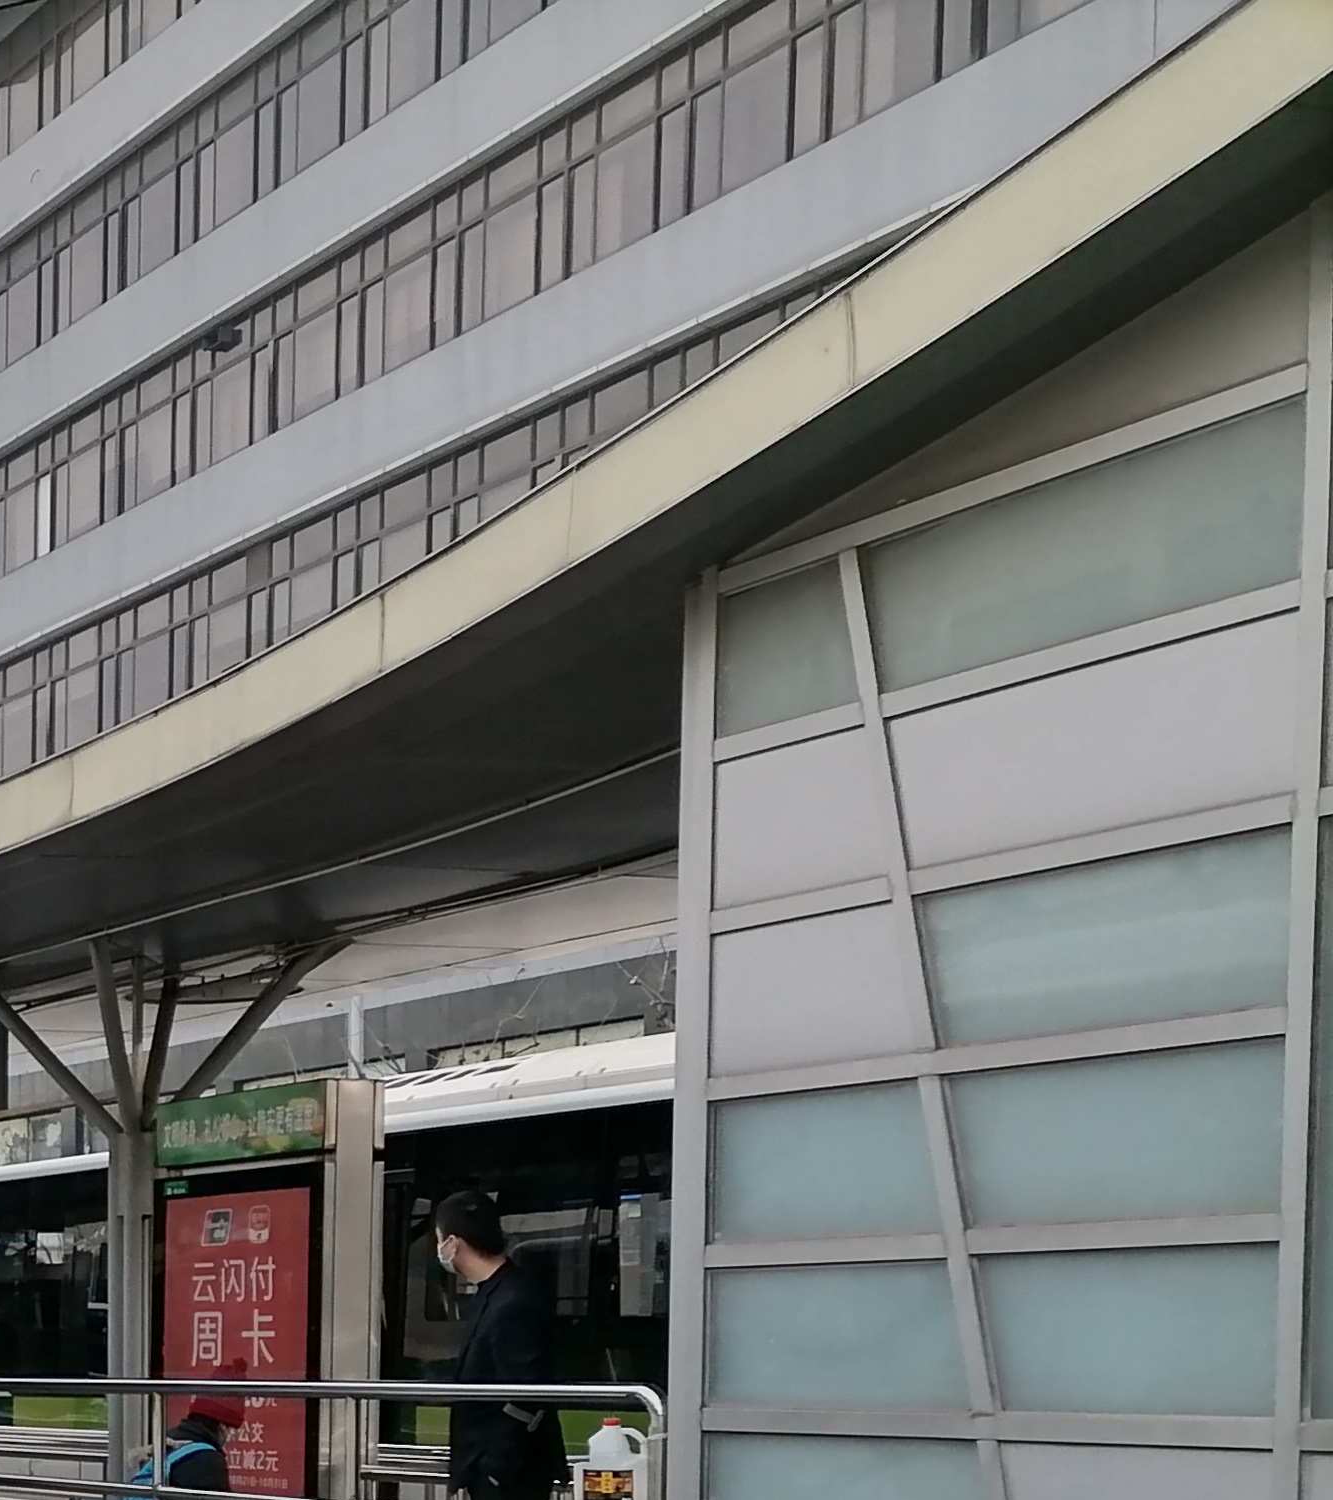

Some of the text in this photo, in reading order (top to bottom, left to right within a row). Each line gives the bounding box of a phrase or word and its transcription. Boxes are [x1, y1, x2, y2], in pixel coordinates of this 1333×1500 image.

[191, 1255, 277, 1303] 云闪付
[223, 1447, 279, 1472] 立减2元
